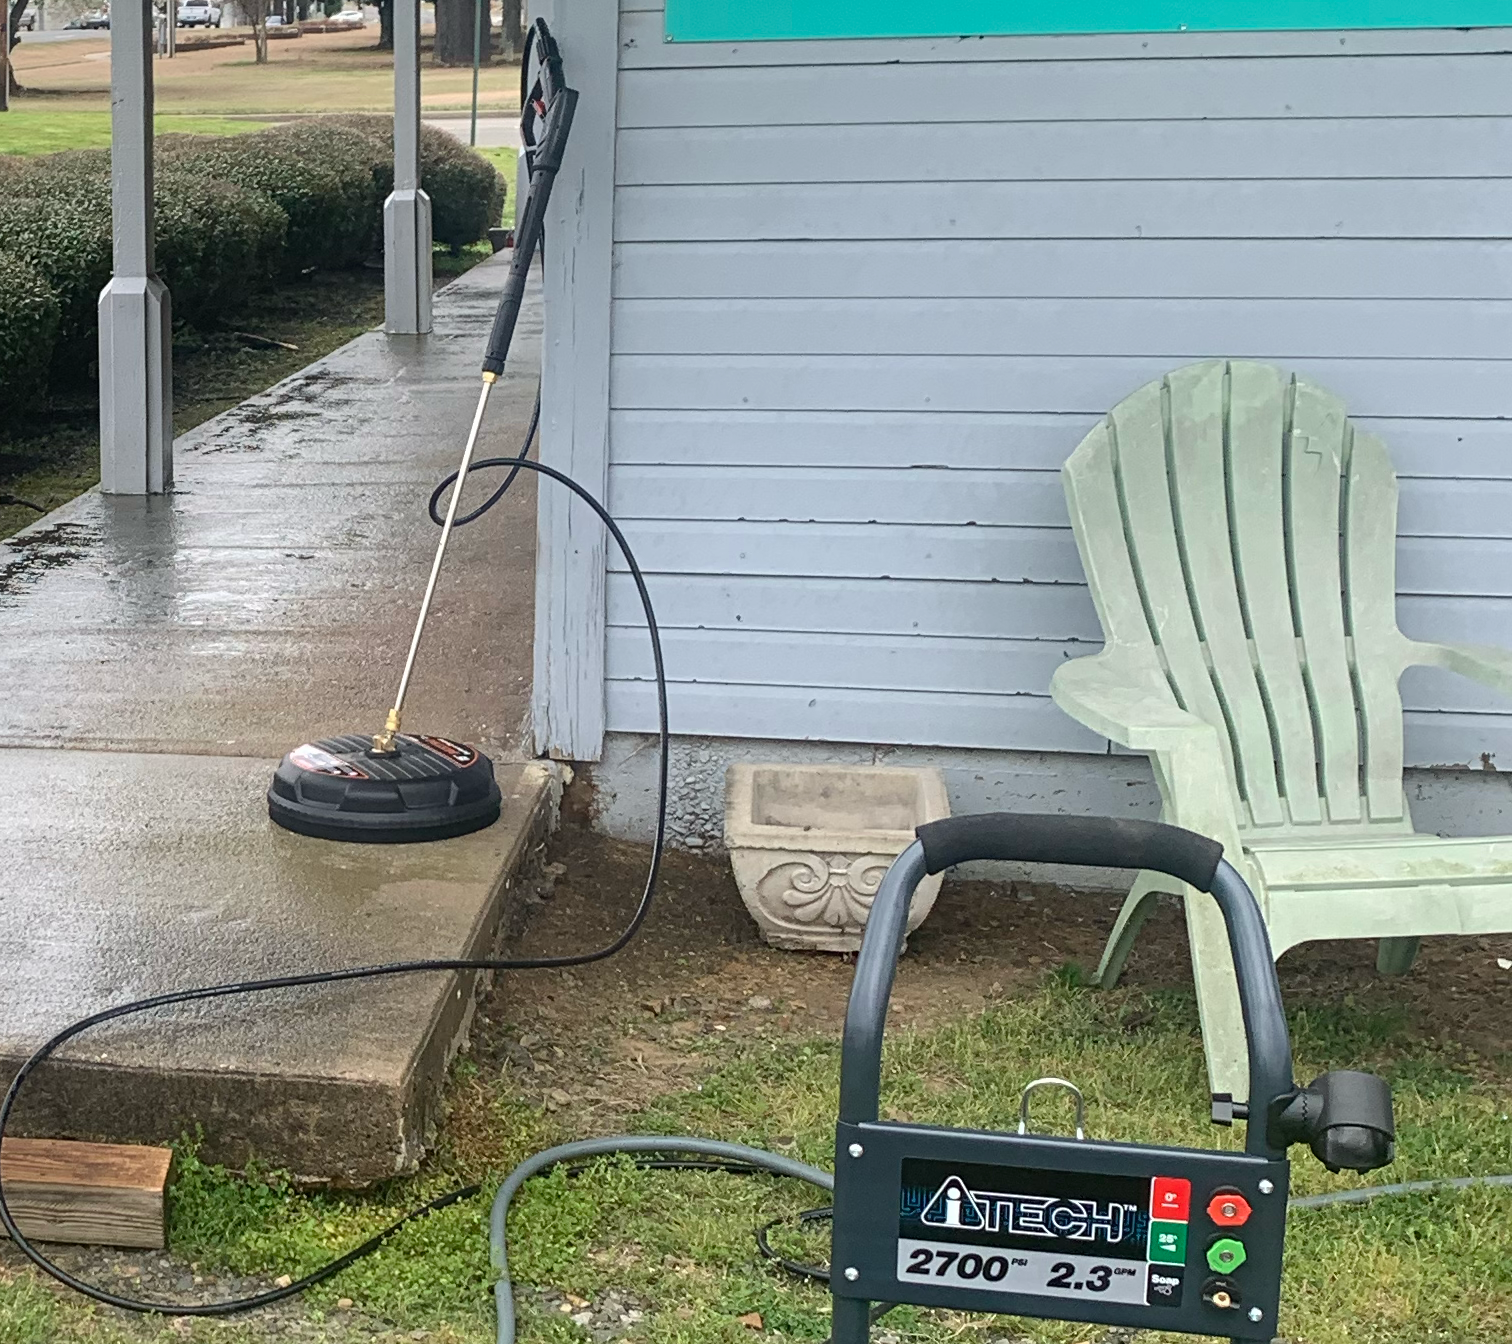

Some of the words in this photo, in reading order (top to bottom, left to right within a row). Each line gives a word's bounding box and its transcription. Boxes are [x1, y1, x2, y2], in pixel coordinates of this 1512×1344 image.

[905, 1248, 1009, 1282] 2700
[1011, 1257, 1028, 1267] PSI
[1046, 1261, 1113, 1292] 2.3
[1113, 1267, 1137, 1277] GPM
[1151, 1273, 1181, 1287] Soap
